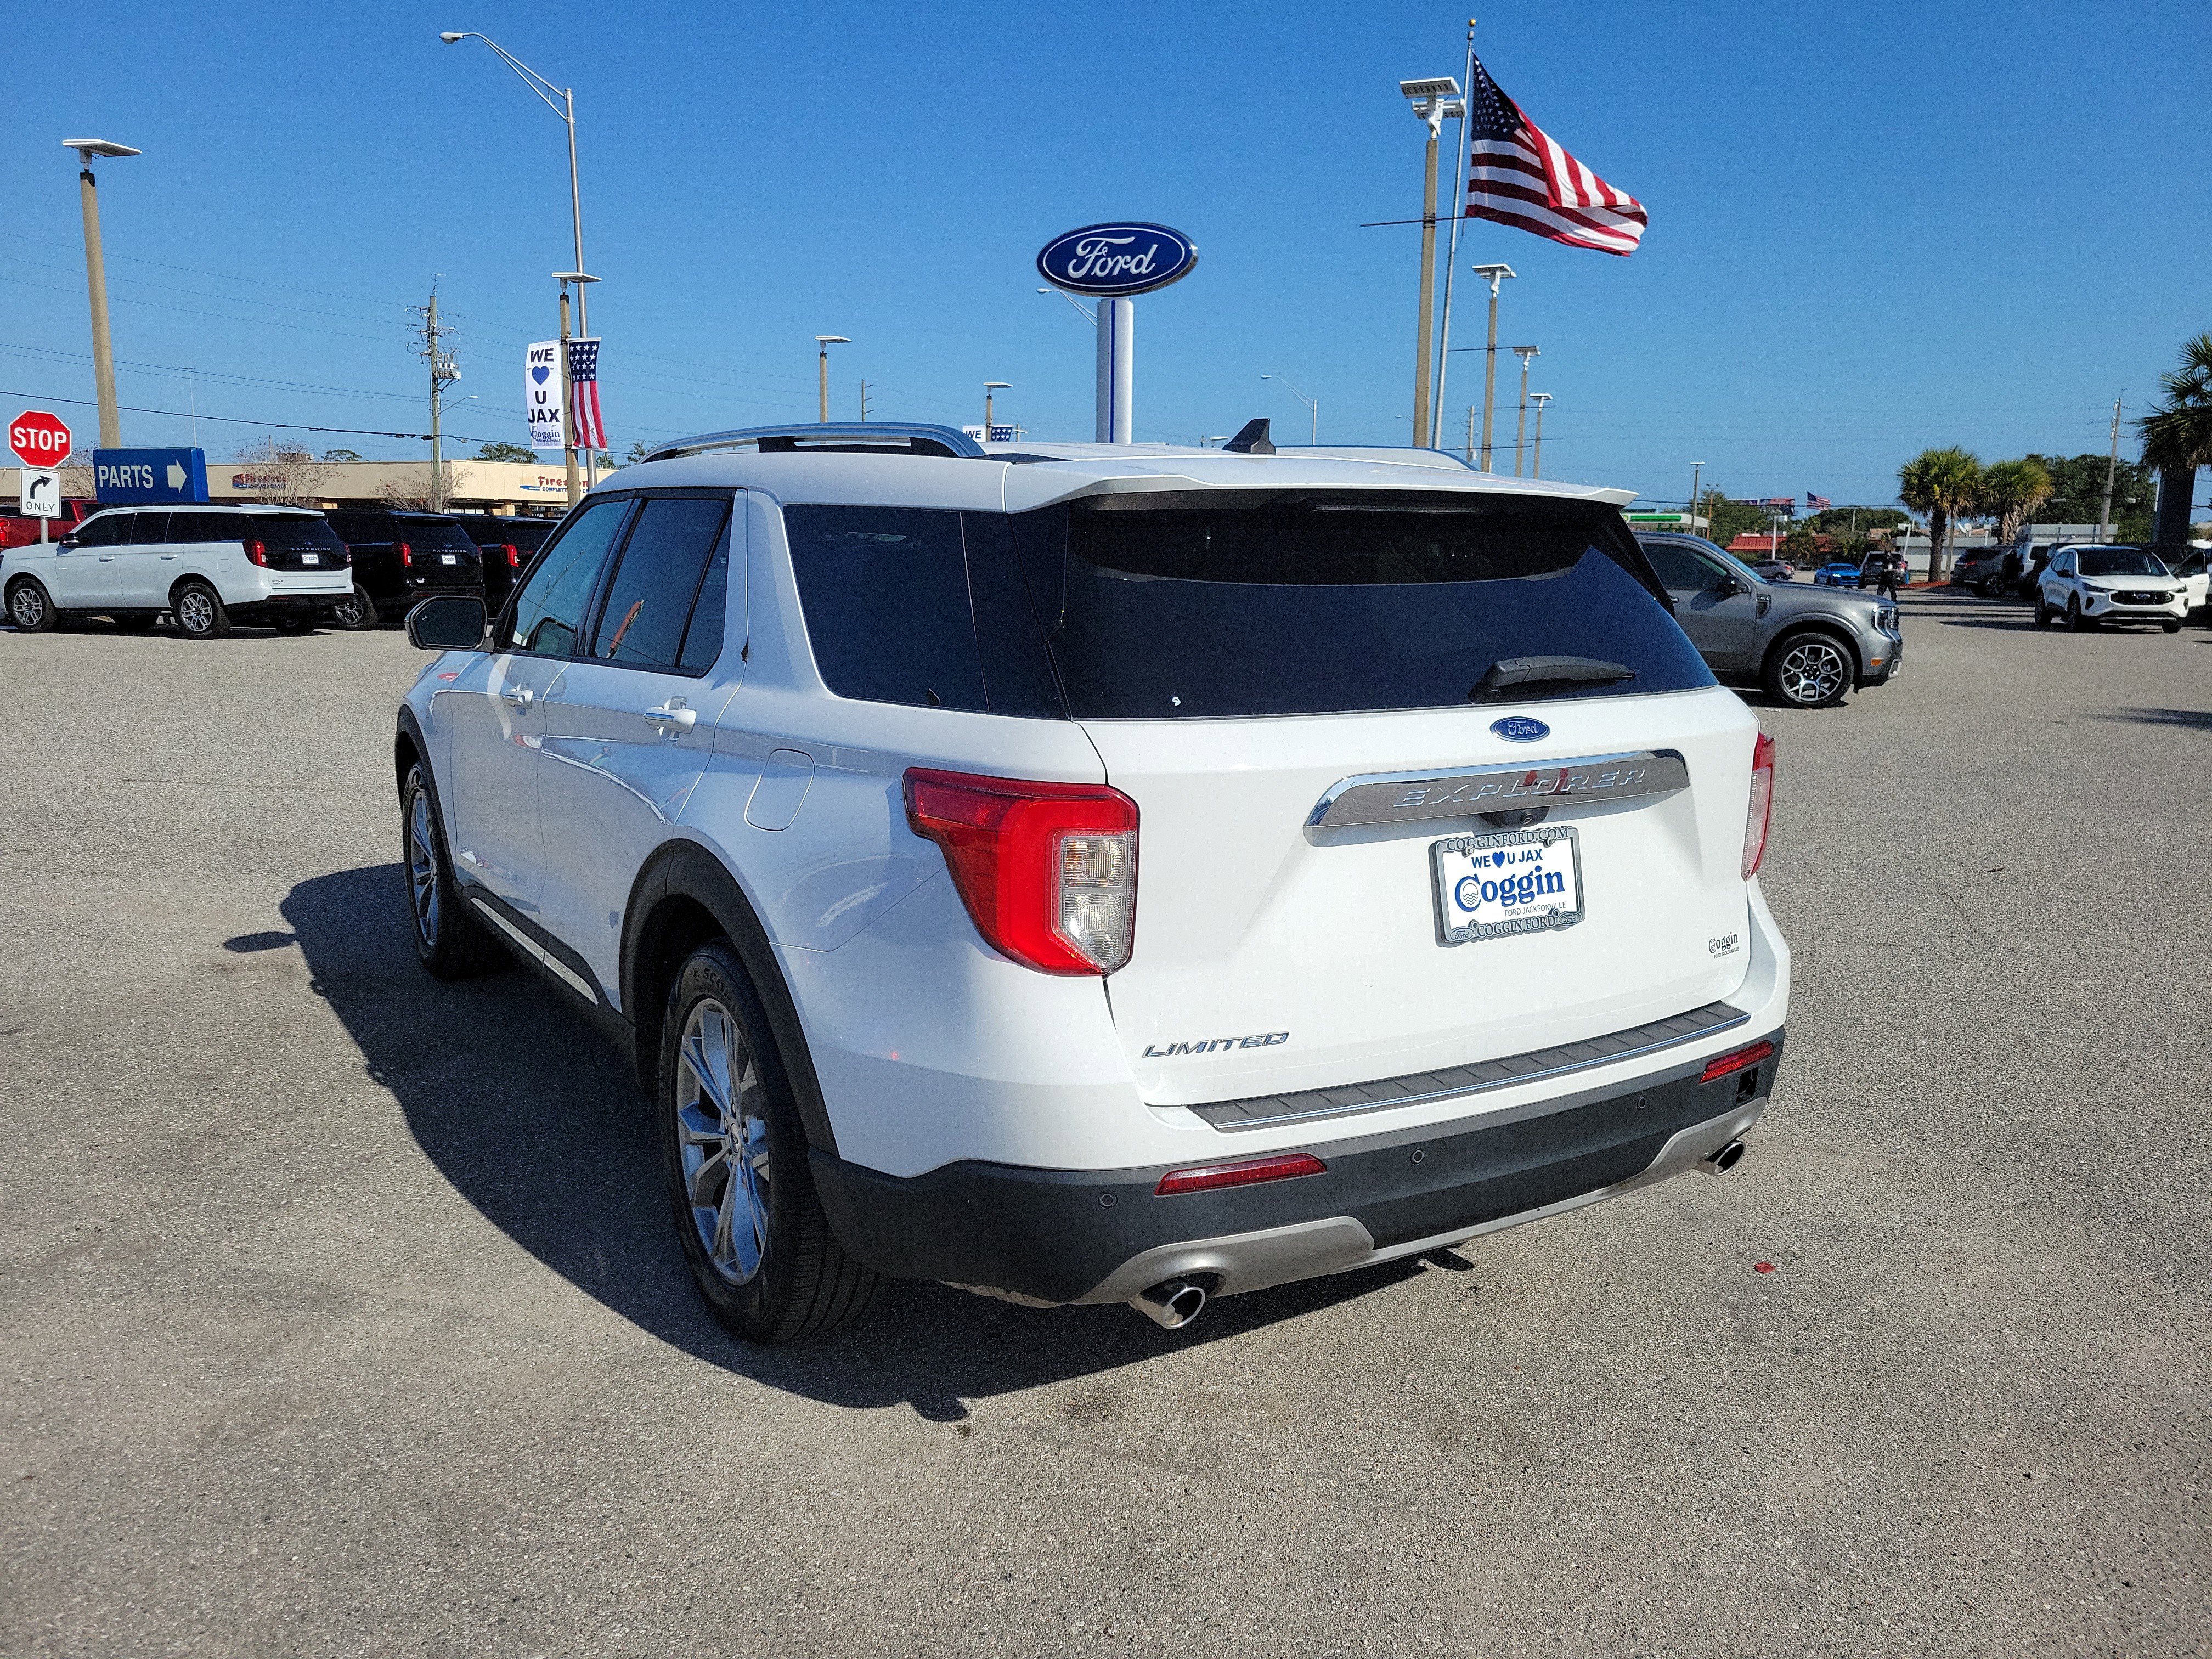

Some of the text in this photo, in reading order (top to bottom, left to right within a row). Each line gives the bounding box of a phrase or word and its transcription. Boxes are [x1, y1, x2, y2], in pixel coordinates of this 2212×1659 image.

[1068, 236, 1158, 278] Ford
[531, 348, 554, 363] WE
[535, 390, 547, 404] U
[528, 409, 560, 424] JAX
[14, 427, 67, 452] STOP
[531, 426, 560, 439] Coggin
[966, 430, 981, 439] WE
[98, 465, 154, 488] PARTS
[538, 476, 589, 487] Firesn
[26, 501, 55, 512] ONLY
[1507, 720, 1539, 736] Ford
[1393, 769, 1646, 808] EXPLORER
[1447, 828, 1569, 851] COGGINFORD.COM
[1471, 849, 1543, 868] WE U JAX
[1454, 865, 1566, 912] Coggin
[1522, 901, 1566, 915] JACKSONVILLE
[1477, 915, 1556, 937] COGGIN FORD
[1563, 915, 1578, 923] Ford
[1454, 930, 1469, 939] Ford
[1709, 931, 1739, 953] Coggin
[1142, 1031, 1290, 1058] LIMITED
